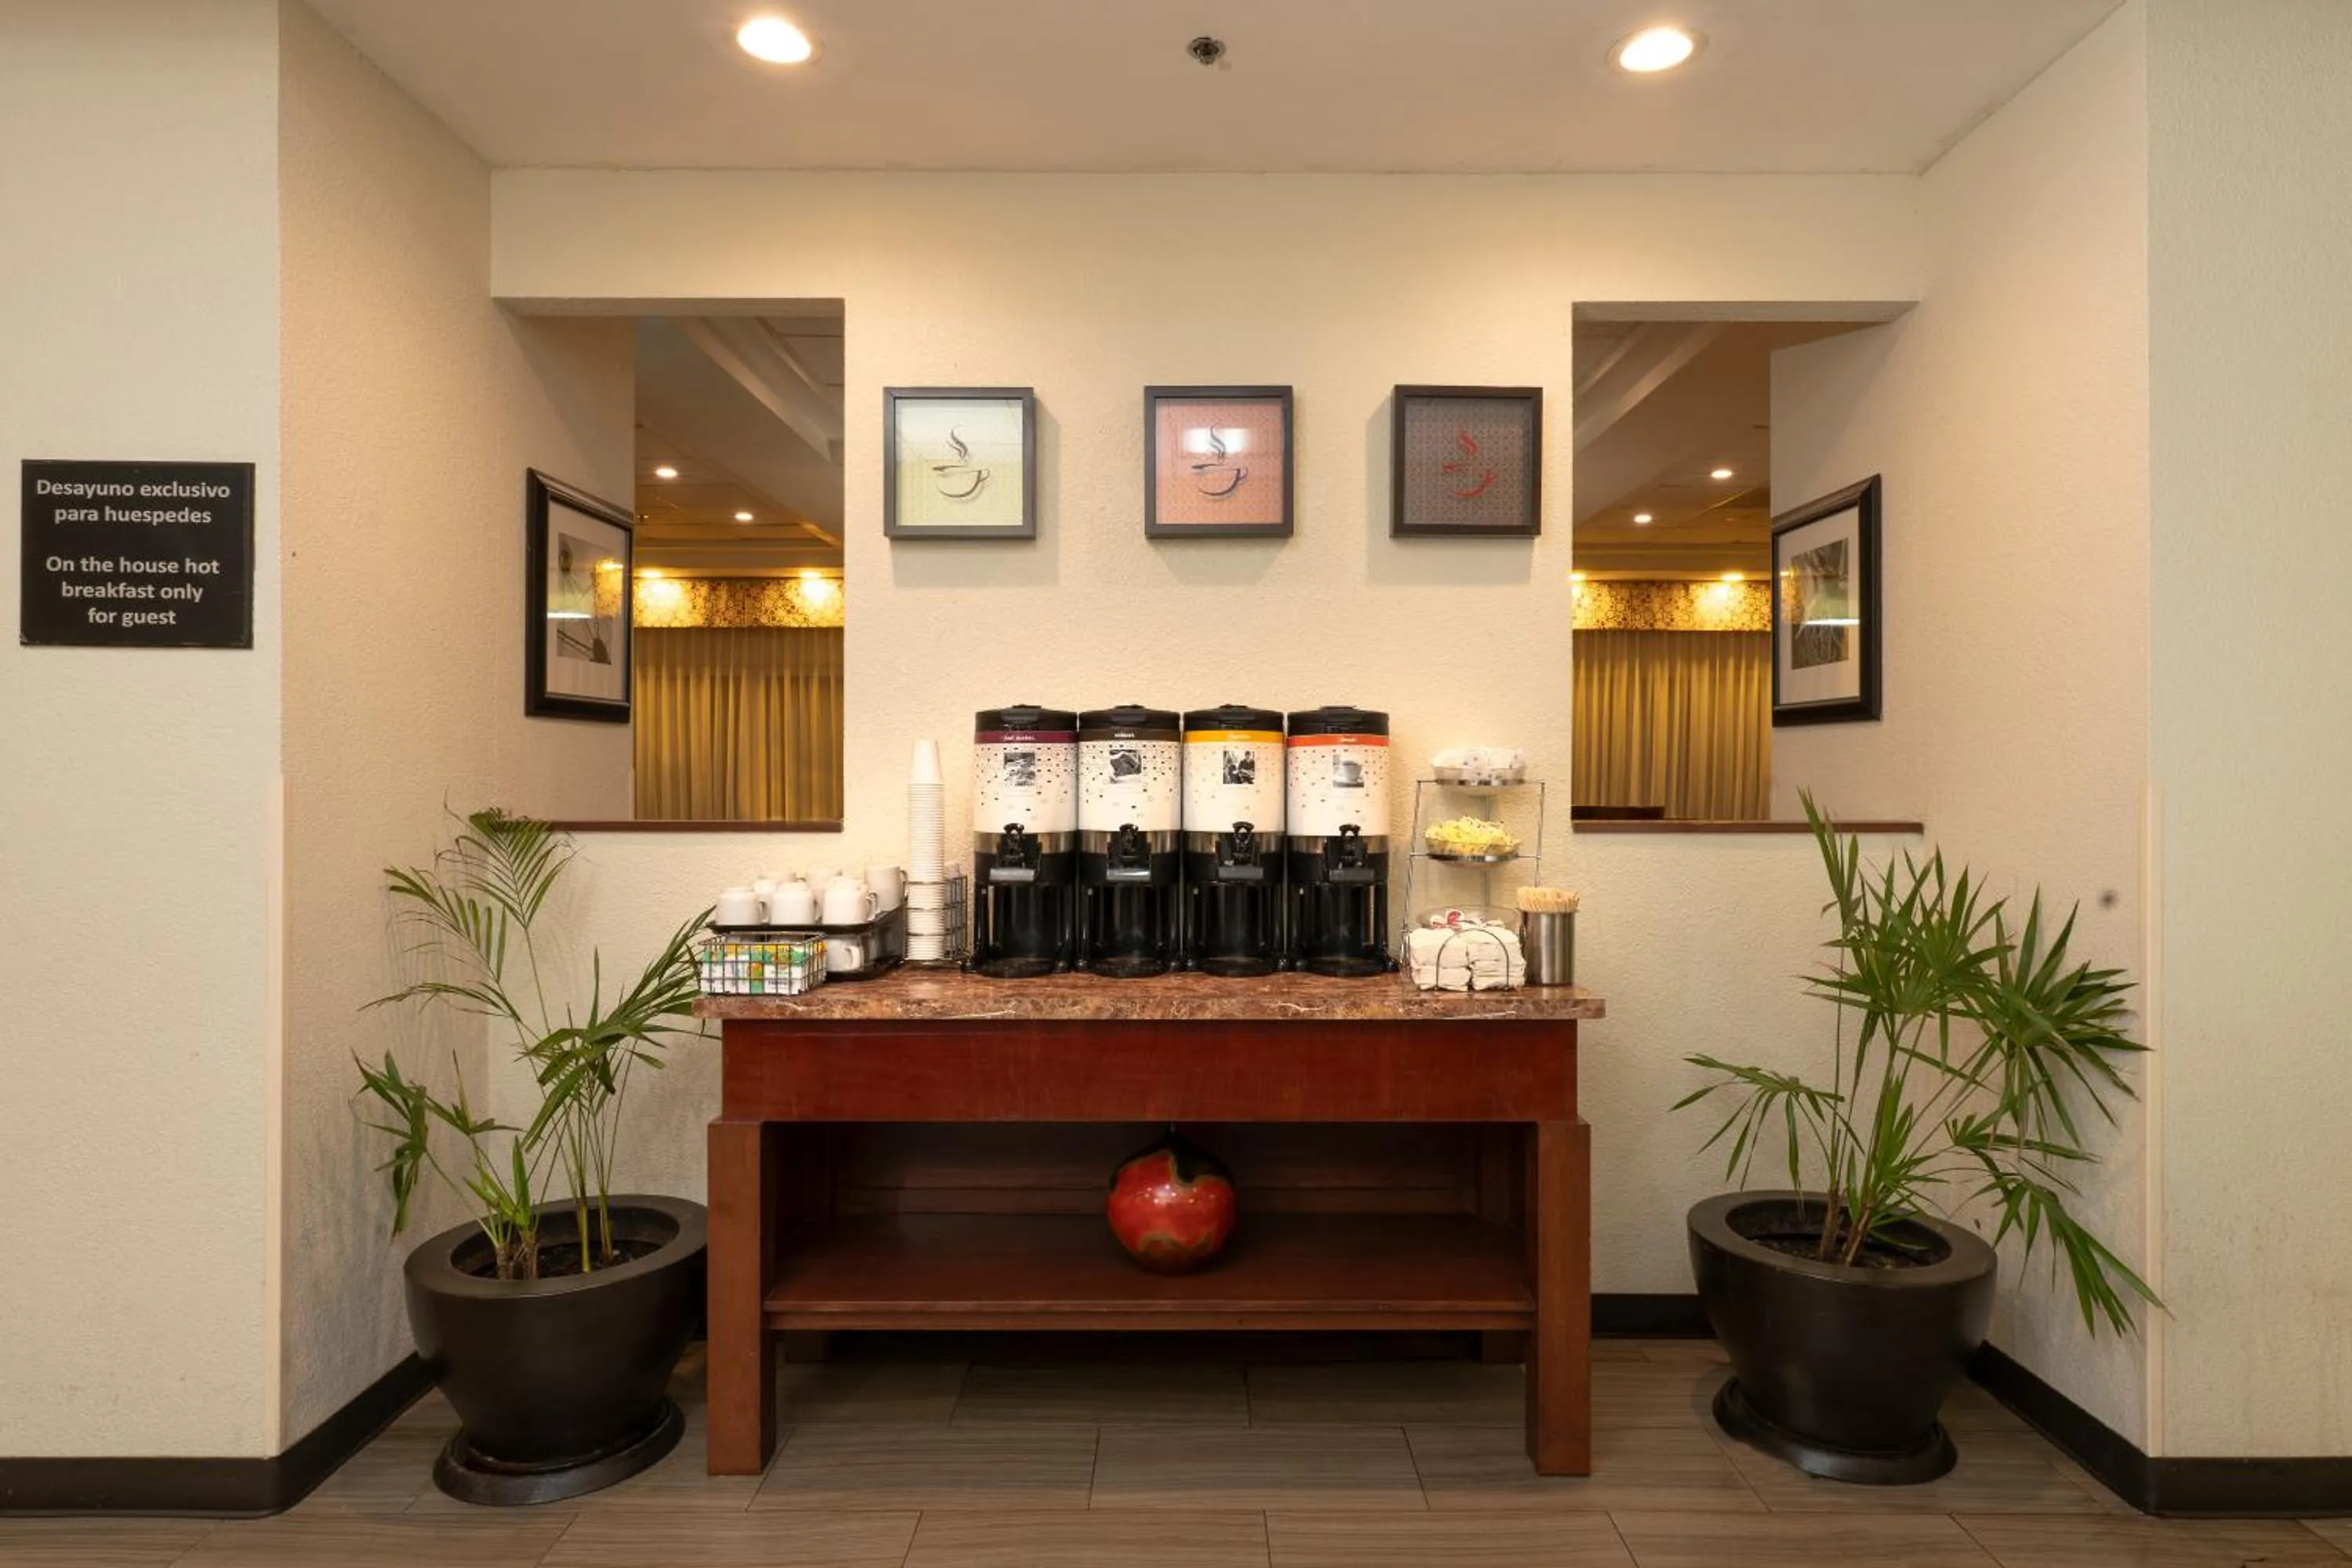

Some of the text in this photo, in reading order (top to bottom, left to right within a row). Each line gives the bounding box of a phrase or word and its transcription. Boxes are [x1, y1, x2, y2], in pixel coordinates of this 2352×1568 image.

[37, 479, 230, 499] Desayuno exclusivo
[55, 506, 212, 525] para huespedes
[46, 556, 220, 575] On the house hot
[62, 582, 203, 603] breakfast only
[88, 608, 176, 627] for guest
